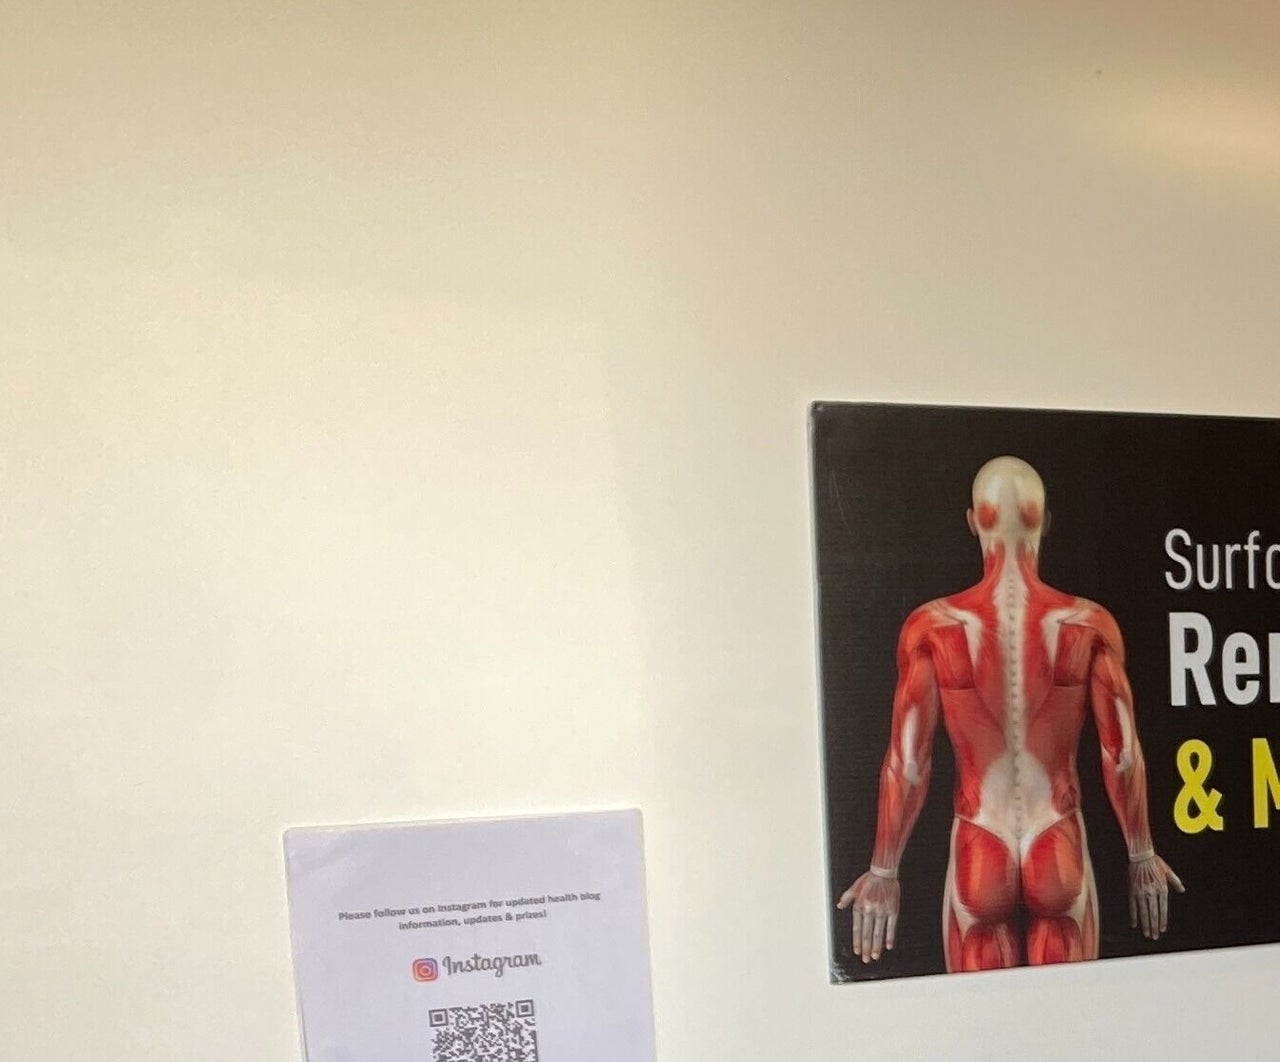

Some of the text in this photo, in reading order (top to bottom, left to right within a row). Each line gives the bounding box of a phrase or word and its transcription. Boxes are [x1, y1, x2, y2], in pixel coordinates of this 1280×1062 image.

[1173, 738, 1224, 834] &
[338, 891, 601, 921] Please follow us on Instagram for updated health blog
[398, 910, 548, 931] information, updates & prizes!
[442, 951, 542, 977] Instagram
